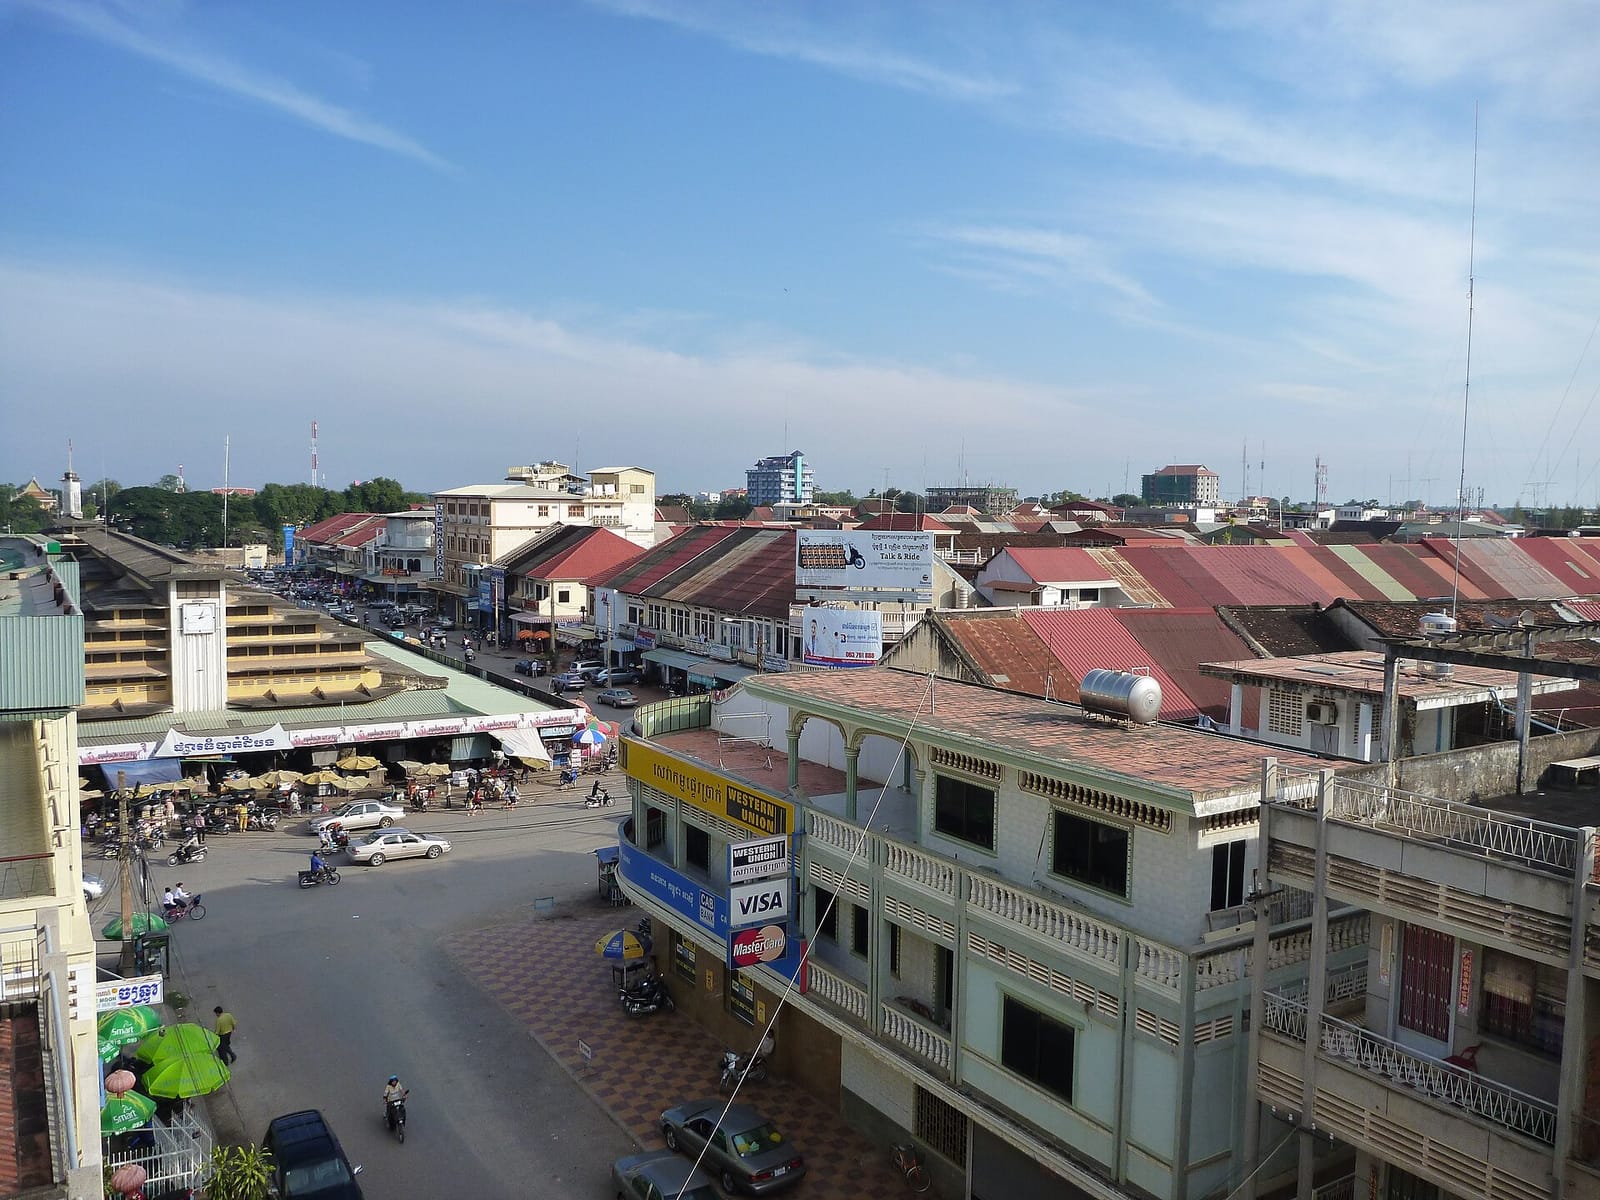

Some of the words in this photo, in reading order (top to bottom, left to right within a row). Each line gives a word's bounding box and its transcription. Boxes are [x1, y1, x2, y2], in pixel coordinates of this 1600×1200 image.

[904, 553, 920, 561] Ride
[728, 787, 775, 817] WESTERN
[741, 808, 775, 833] UNION
[733, 843, 776, 859] WESTERN
[747, 852, 776, 863] UNION
[701, 893, 714, 910] CAB
[737, 891, 783, 916] VISA
[701, 909, 714, 922] BANK
[733, 933, 785, 957] MasterCard
[111, 1026, 134, 1036] Smart
[112, 1110, 137, 1124] Smart
